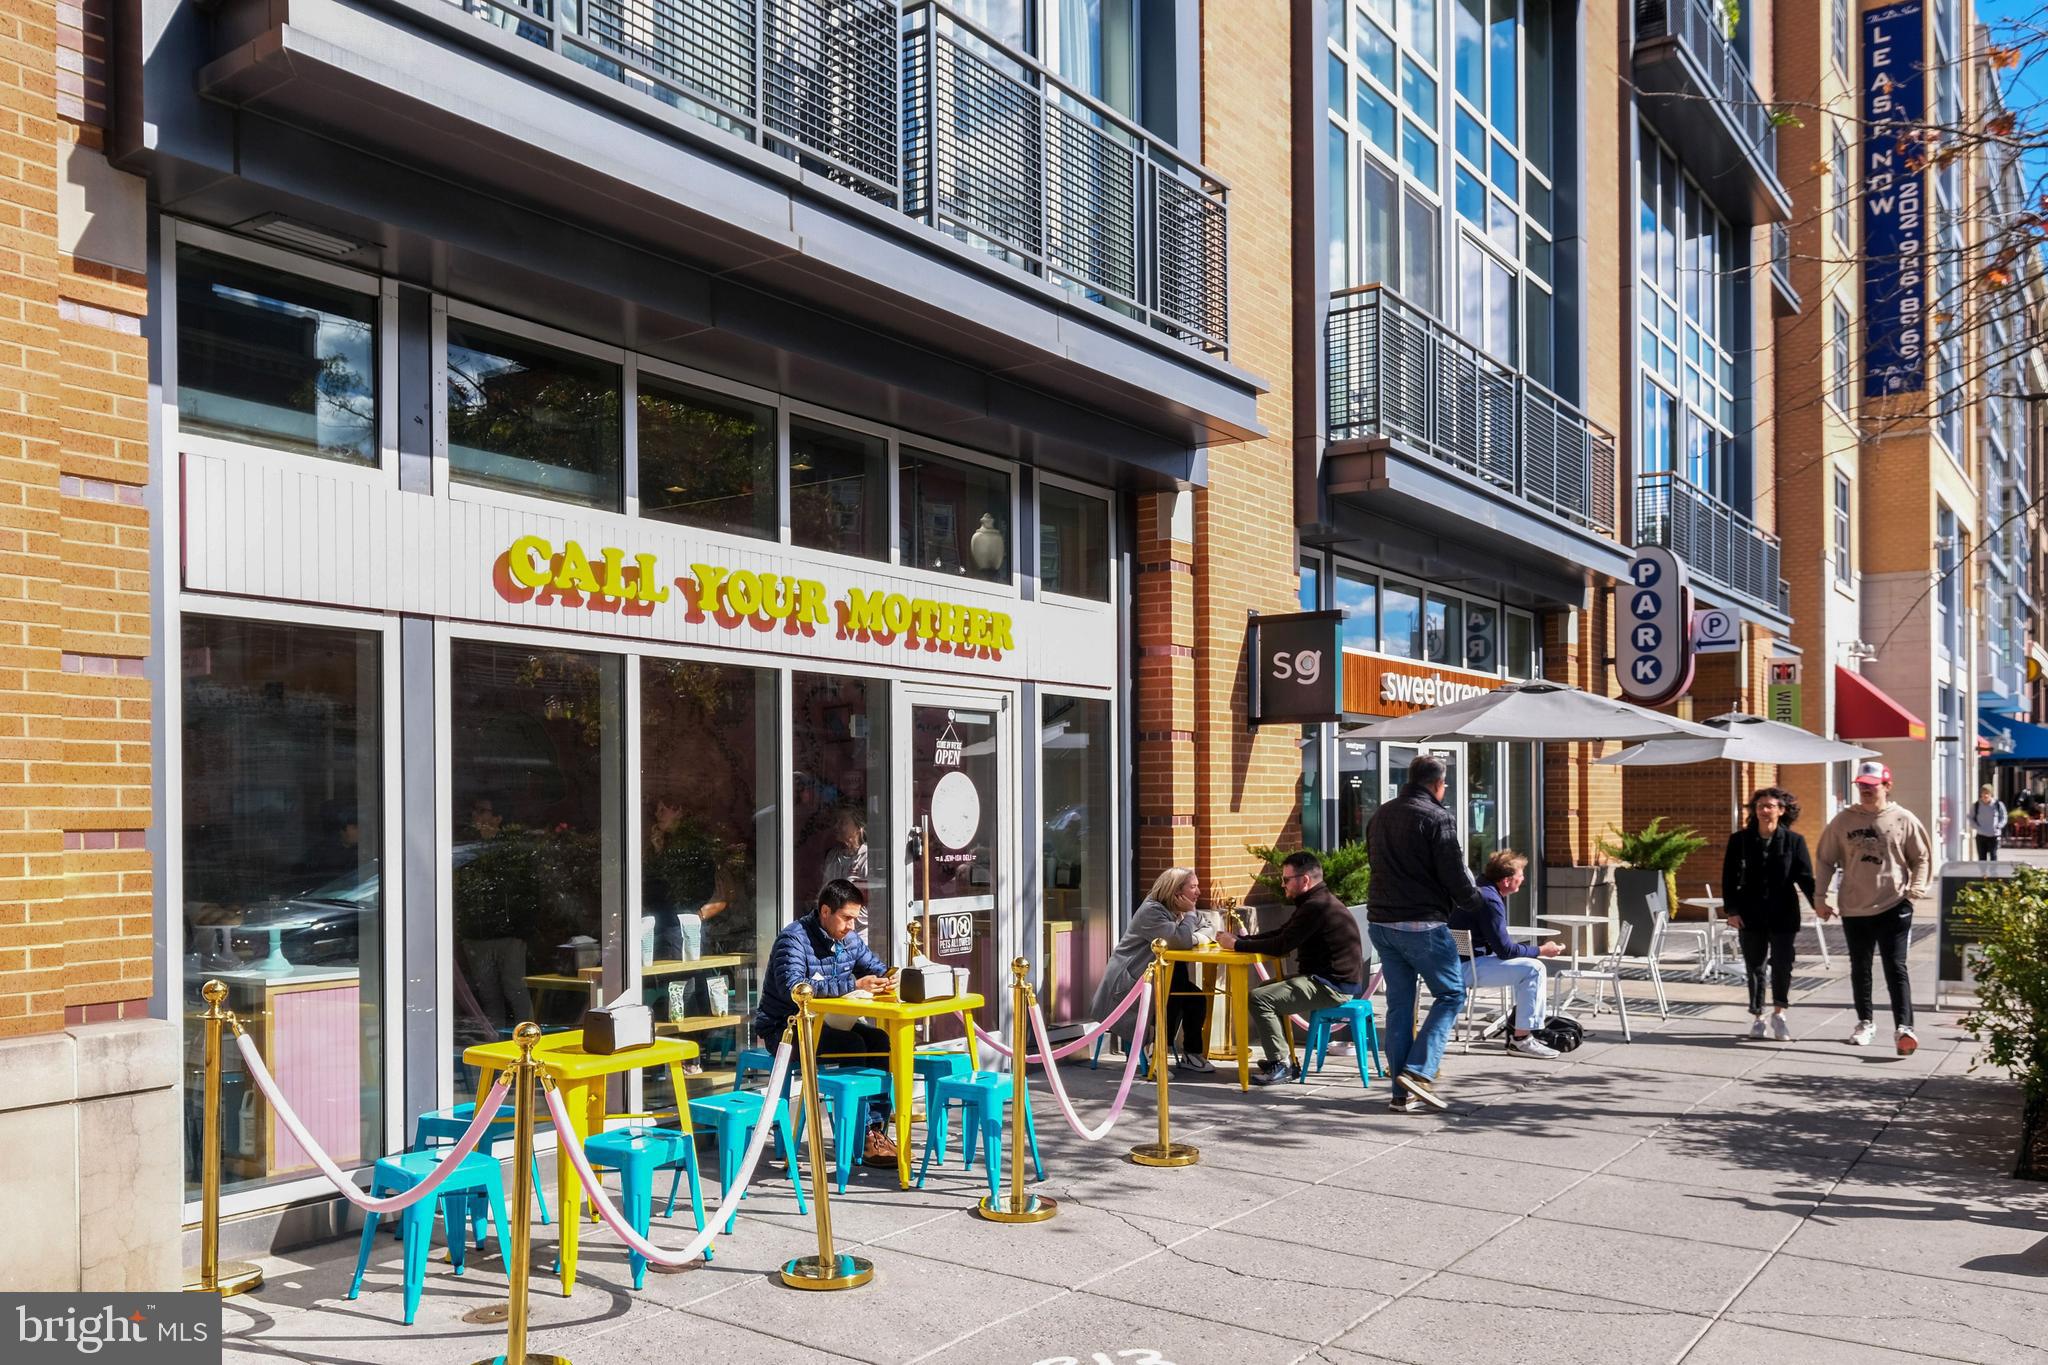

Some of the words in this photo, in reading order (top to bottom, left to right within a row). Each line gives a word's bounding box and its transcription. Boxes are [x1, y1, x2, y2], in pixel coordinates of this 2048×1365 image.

[509, 535, 670, 604] CALL
[689, 563, 830, 625] YOUR
[847, 588, 1015, 651] MOTHER
[1636, 563, 1657, 680] PARK
[1272, 649, 1322, 685] sg
[935, 749, 961, 766] OPEN
[940, 916, 957, 940] NO
[940, 939, 951, 949] PETS
